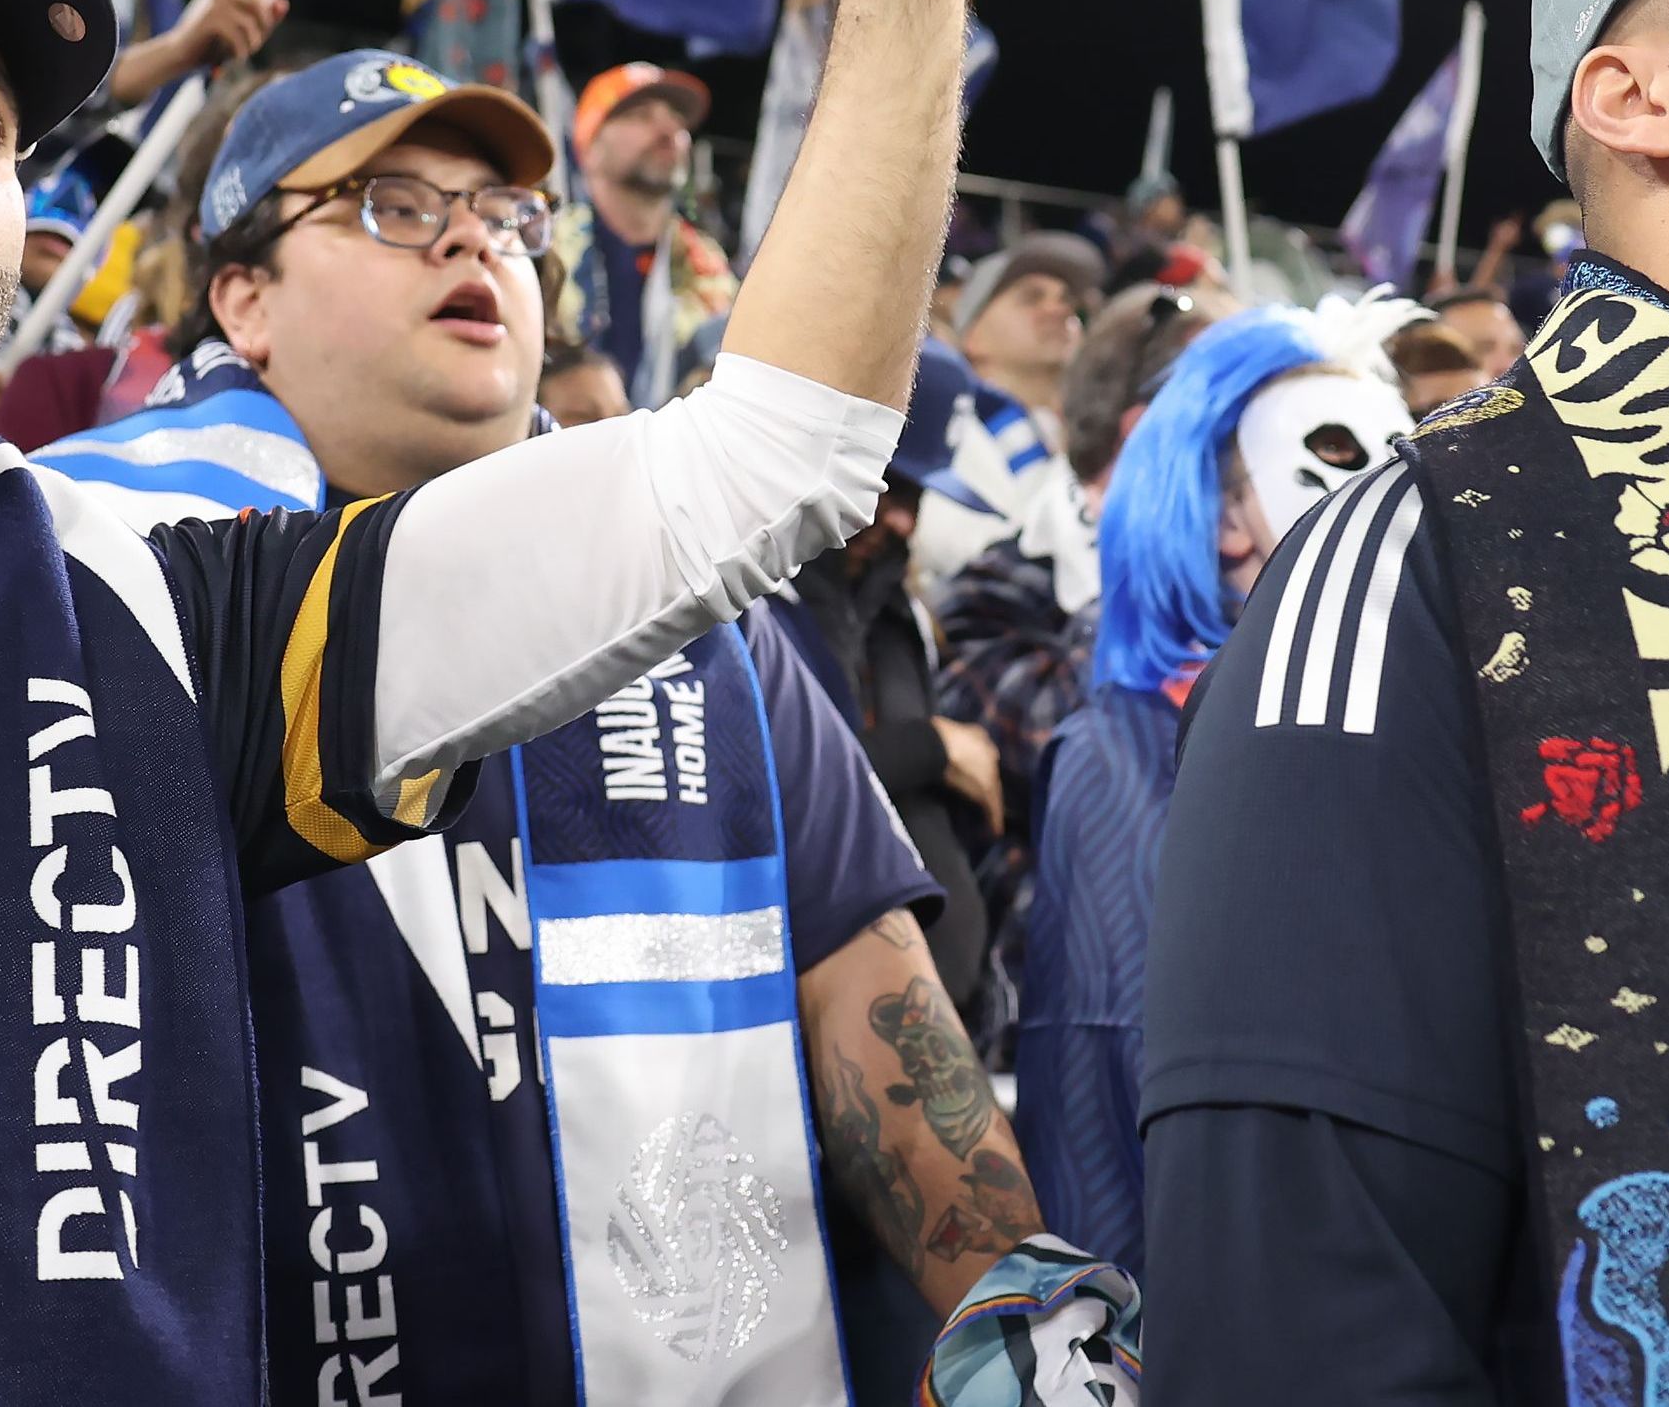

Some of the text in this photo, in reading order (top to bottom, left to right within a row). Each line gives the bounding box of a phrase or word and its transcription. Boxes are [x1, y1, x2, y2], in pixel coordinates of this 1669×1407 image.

[661, 679, 708, 805] HOME
[28, 677, 143, 1282] DIRECTV
[300, 1065, 403, 1407] RECTV
